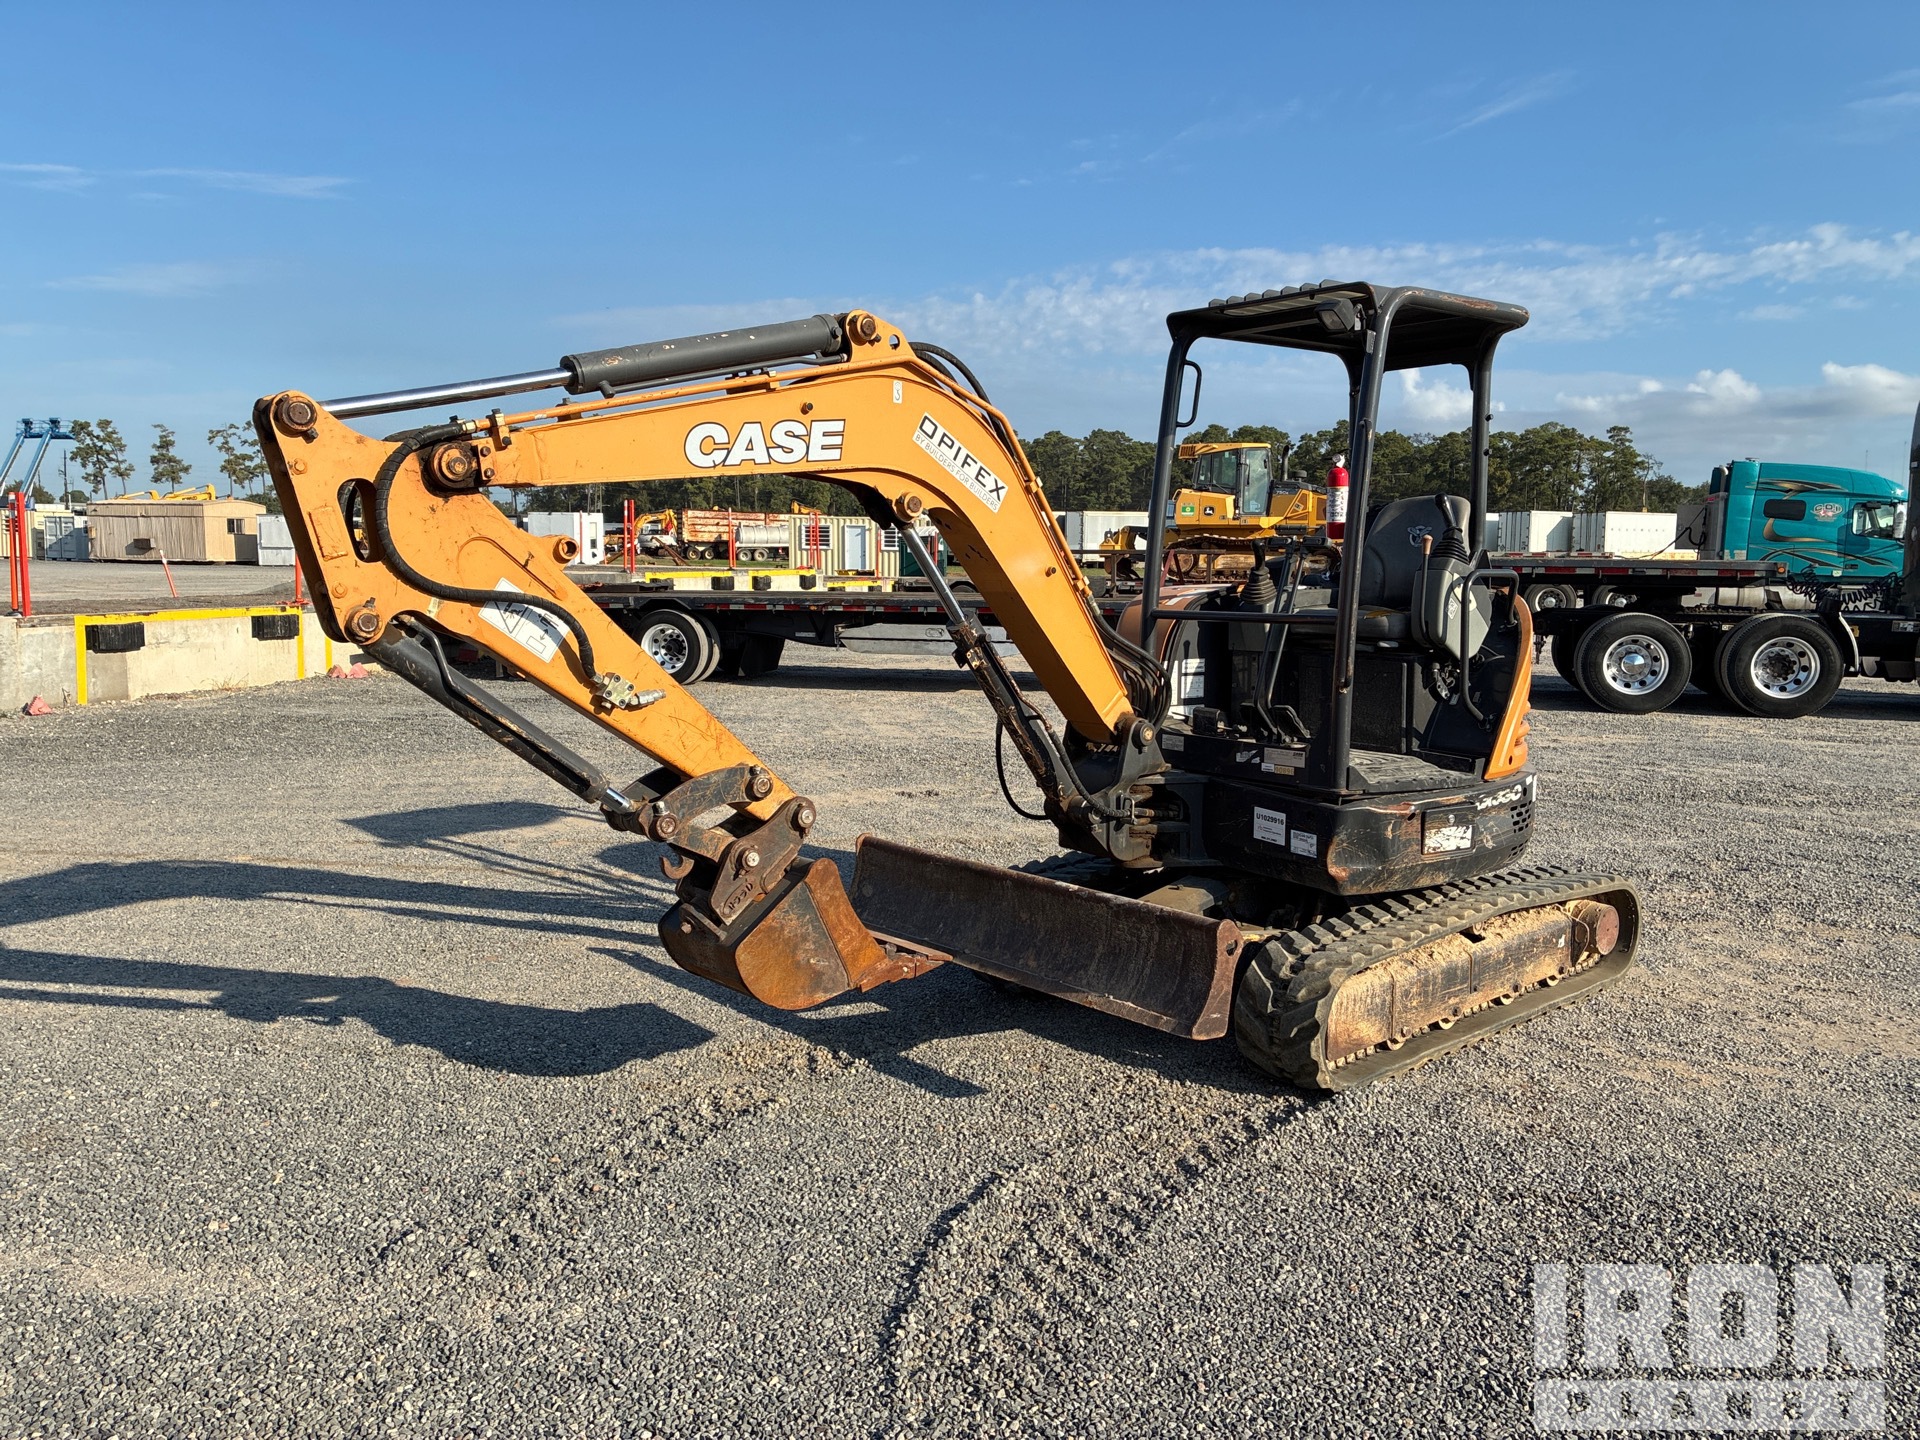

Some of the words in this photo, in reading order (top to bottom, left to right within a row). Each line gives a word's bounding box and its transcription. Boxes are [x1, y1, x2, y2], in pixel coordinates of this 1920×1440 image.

[684, 419, 846, 469] CASE
[915, 433, 926, 445] BY
[925, 442, 956, 473] BUILDERS
[955, 470, 971, 485] FOR
[970, 482, 1000, 511] BUILDERS
[918, 415, 1006, 502] OPIFEX
